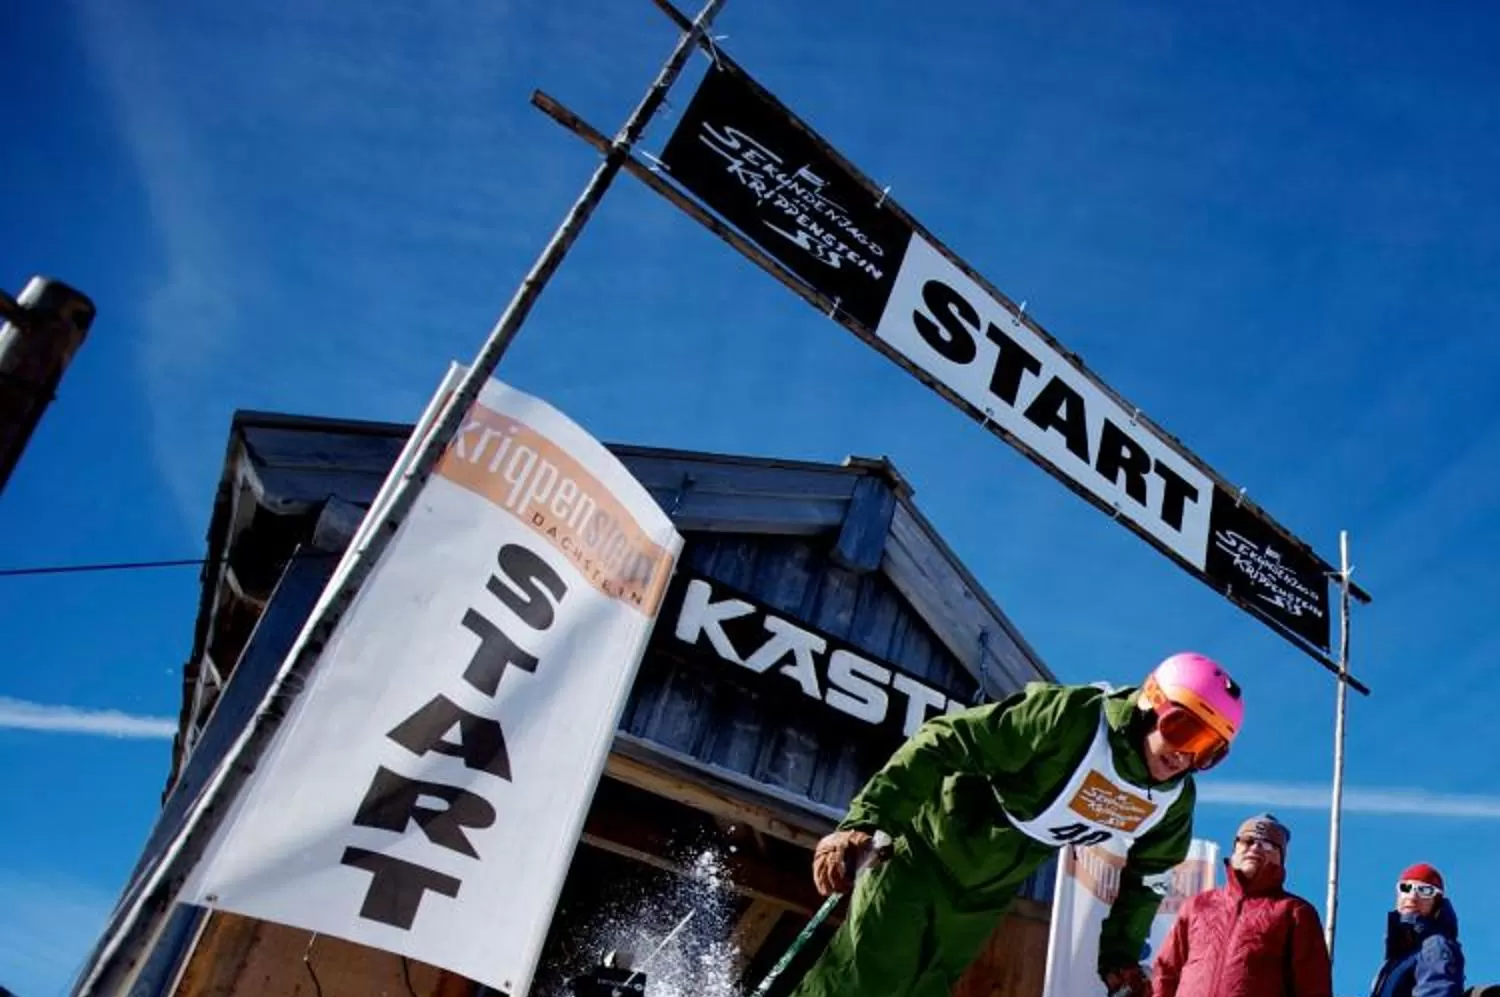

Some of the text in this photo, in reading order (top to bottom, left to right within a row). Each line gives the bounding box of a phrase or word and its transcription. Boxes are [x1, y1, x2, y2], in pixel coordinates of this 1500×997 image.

[912, 279, 1199, 535] START
[341, 543, 568, 931] START
[675, 579, 967, 739] KAST
